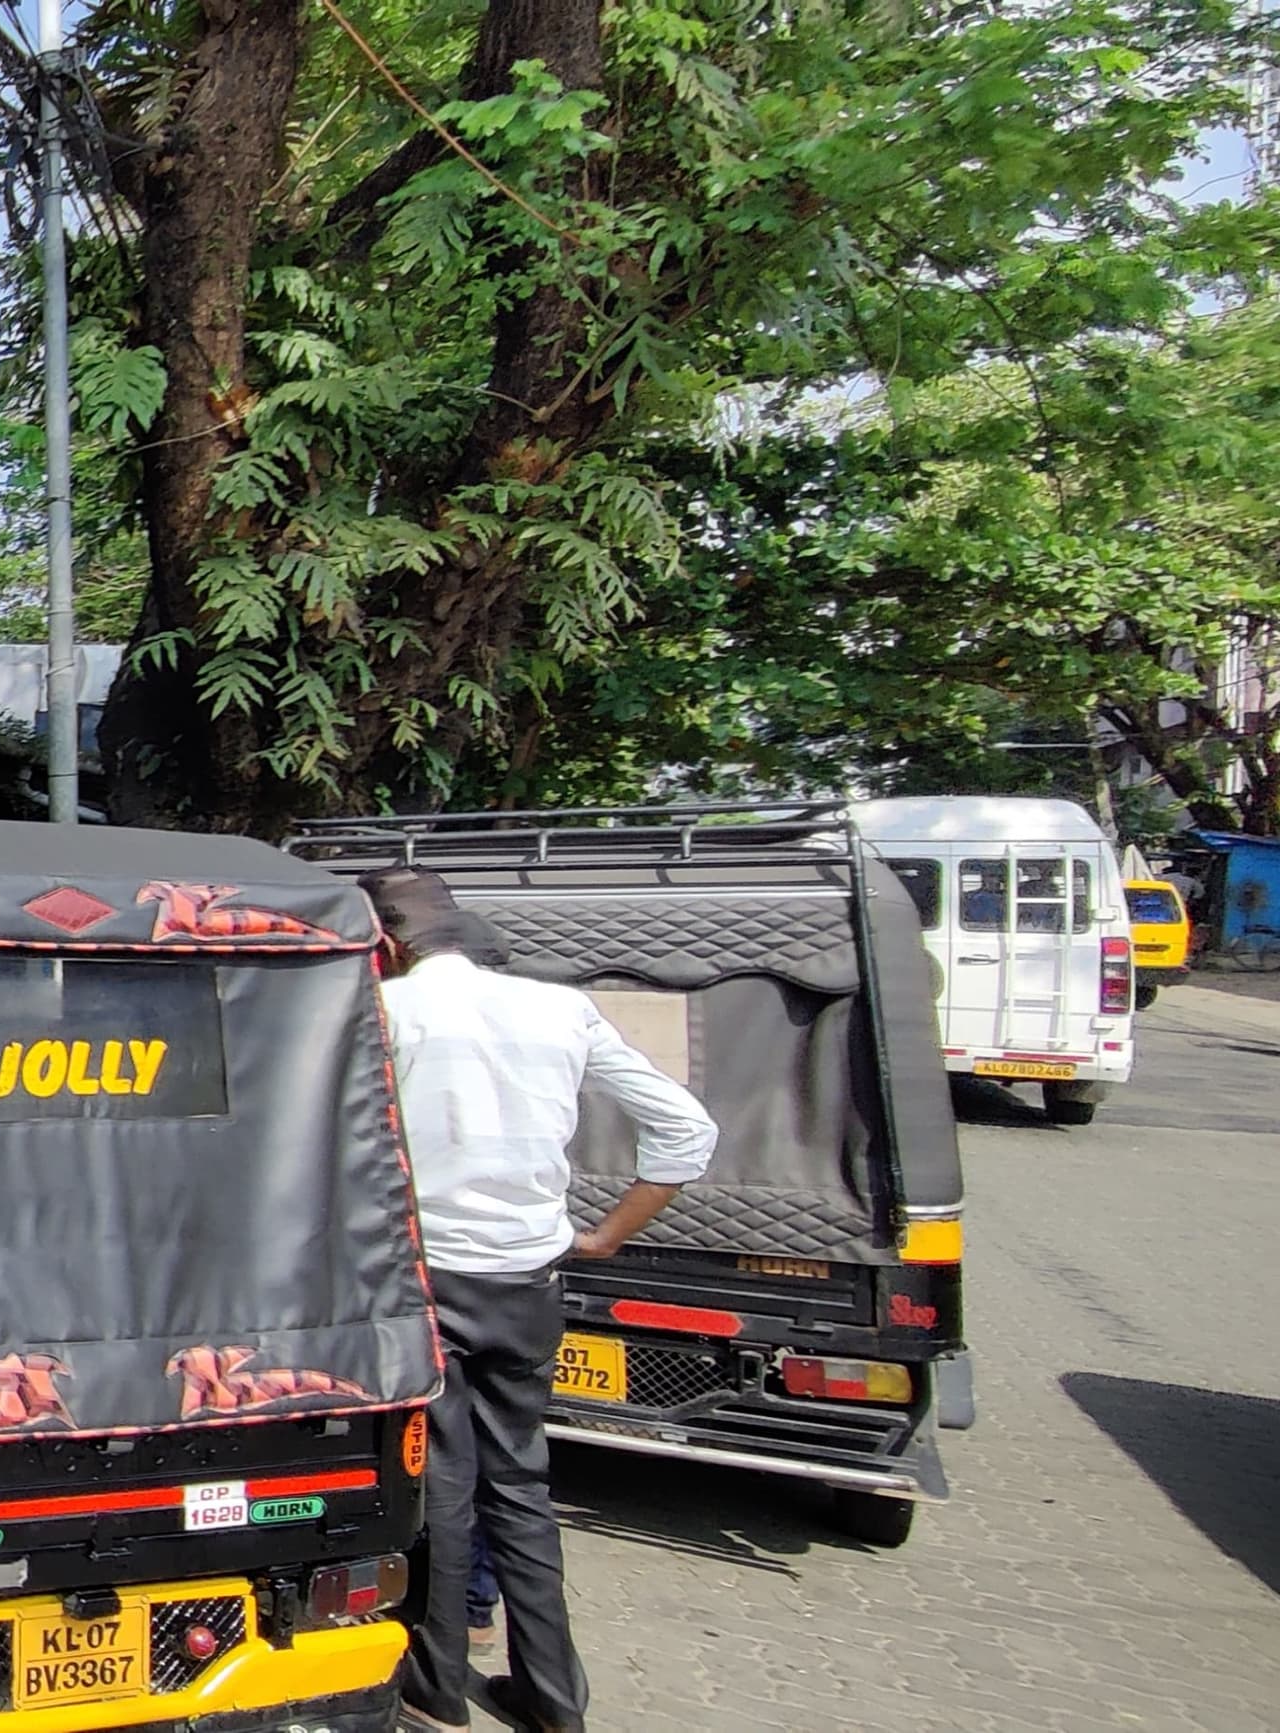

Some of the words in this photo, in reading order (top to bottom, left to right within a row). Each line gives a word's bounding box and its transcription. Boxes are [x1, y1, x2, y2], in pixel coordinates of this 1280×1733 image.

[411, 1421, 423, 1467] STOP
[200, 1487, 229, 1501] CP
[192, 1505, 243, 1526] 1628
[263, 1501, 313, 1518] HORN
